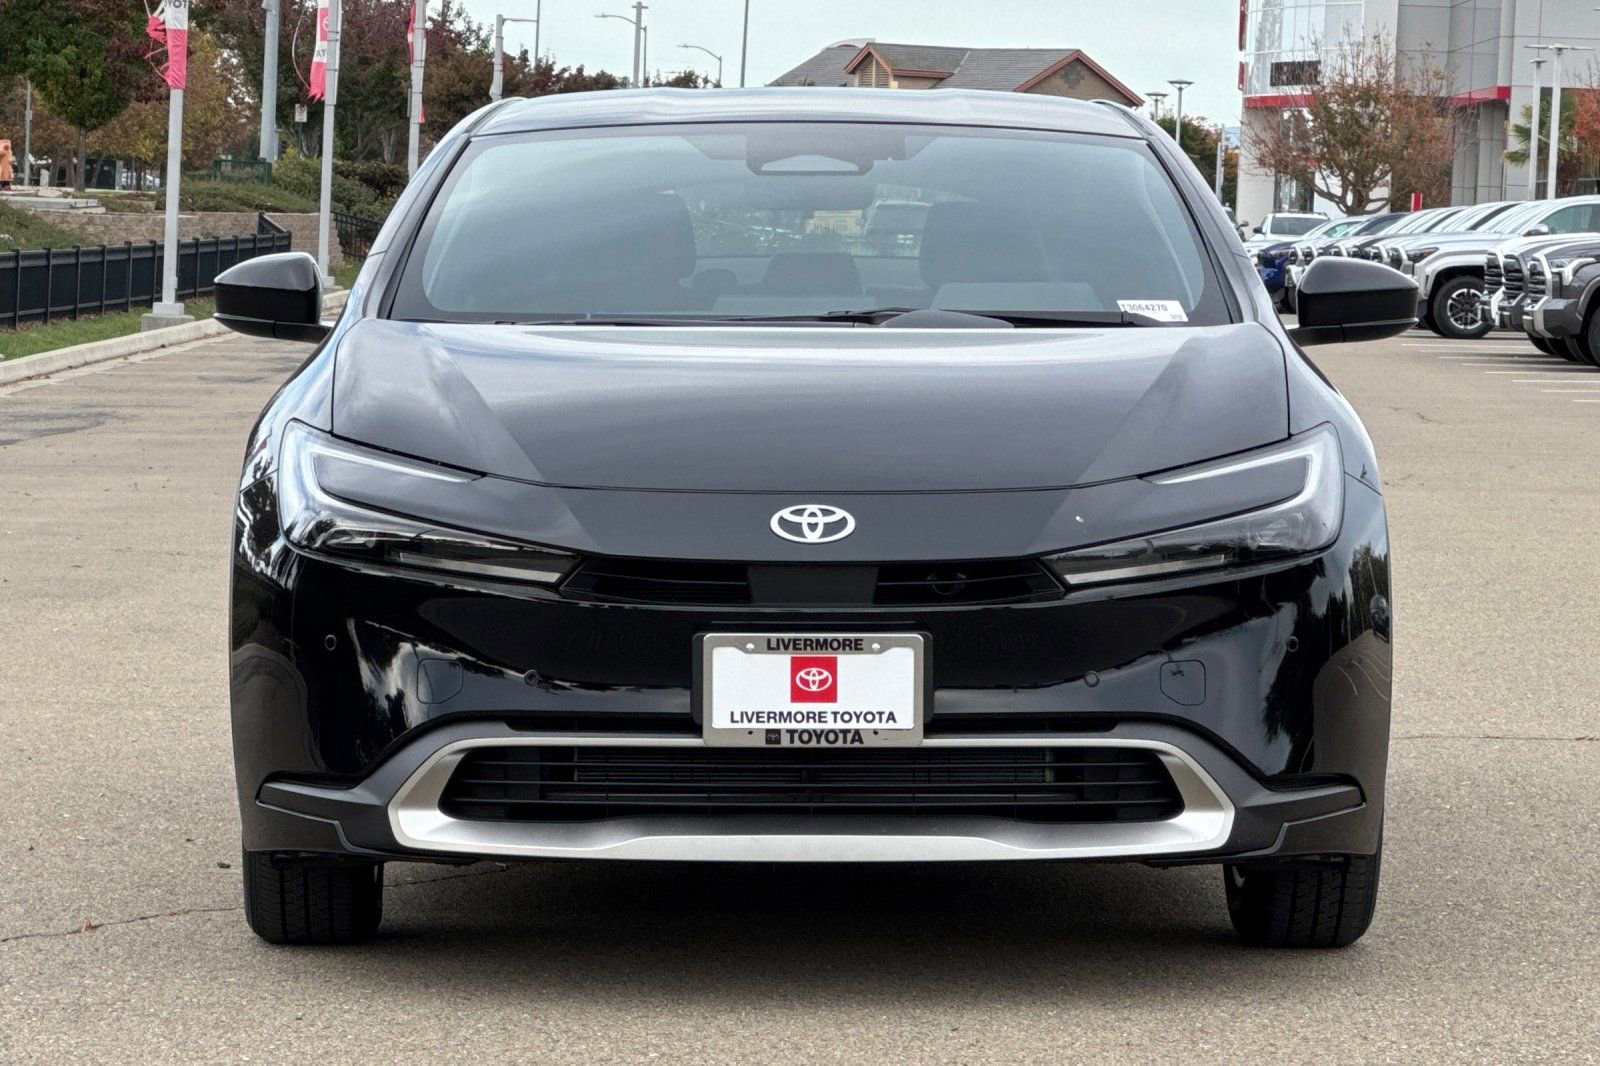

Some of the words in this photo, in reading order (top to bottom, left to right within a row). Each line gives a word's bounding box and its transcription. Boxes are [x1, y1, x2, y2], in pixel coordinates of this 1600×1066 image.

[766, 638, 864, 651] LIVERMORE
[730, 711, 828, 724] LIVERMORE
[831, 711, 897, 724] TOYOTA
[786, 729, 864, 745] TOYOTA
